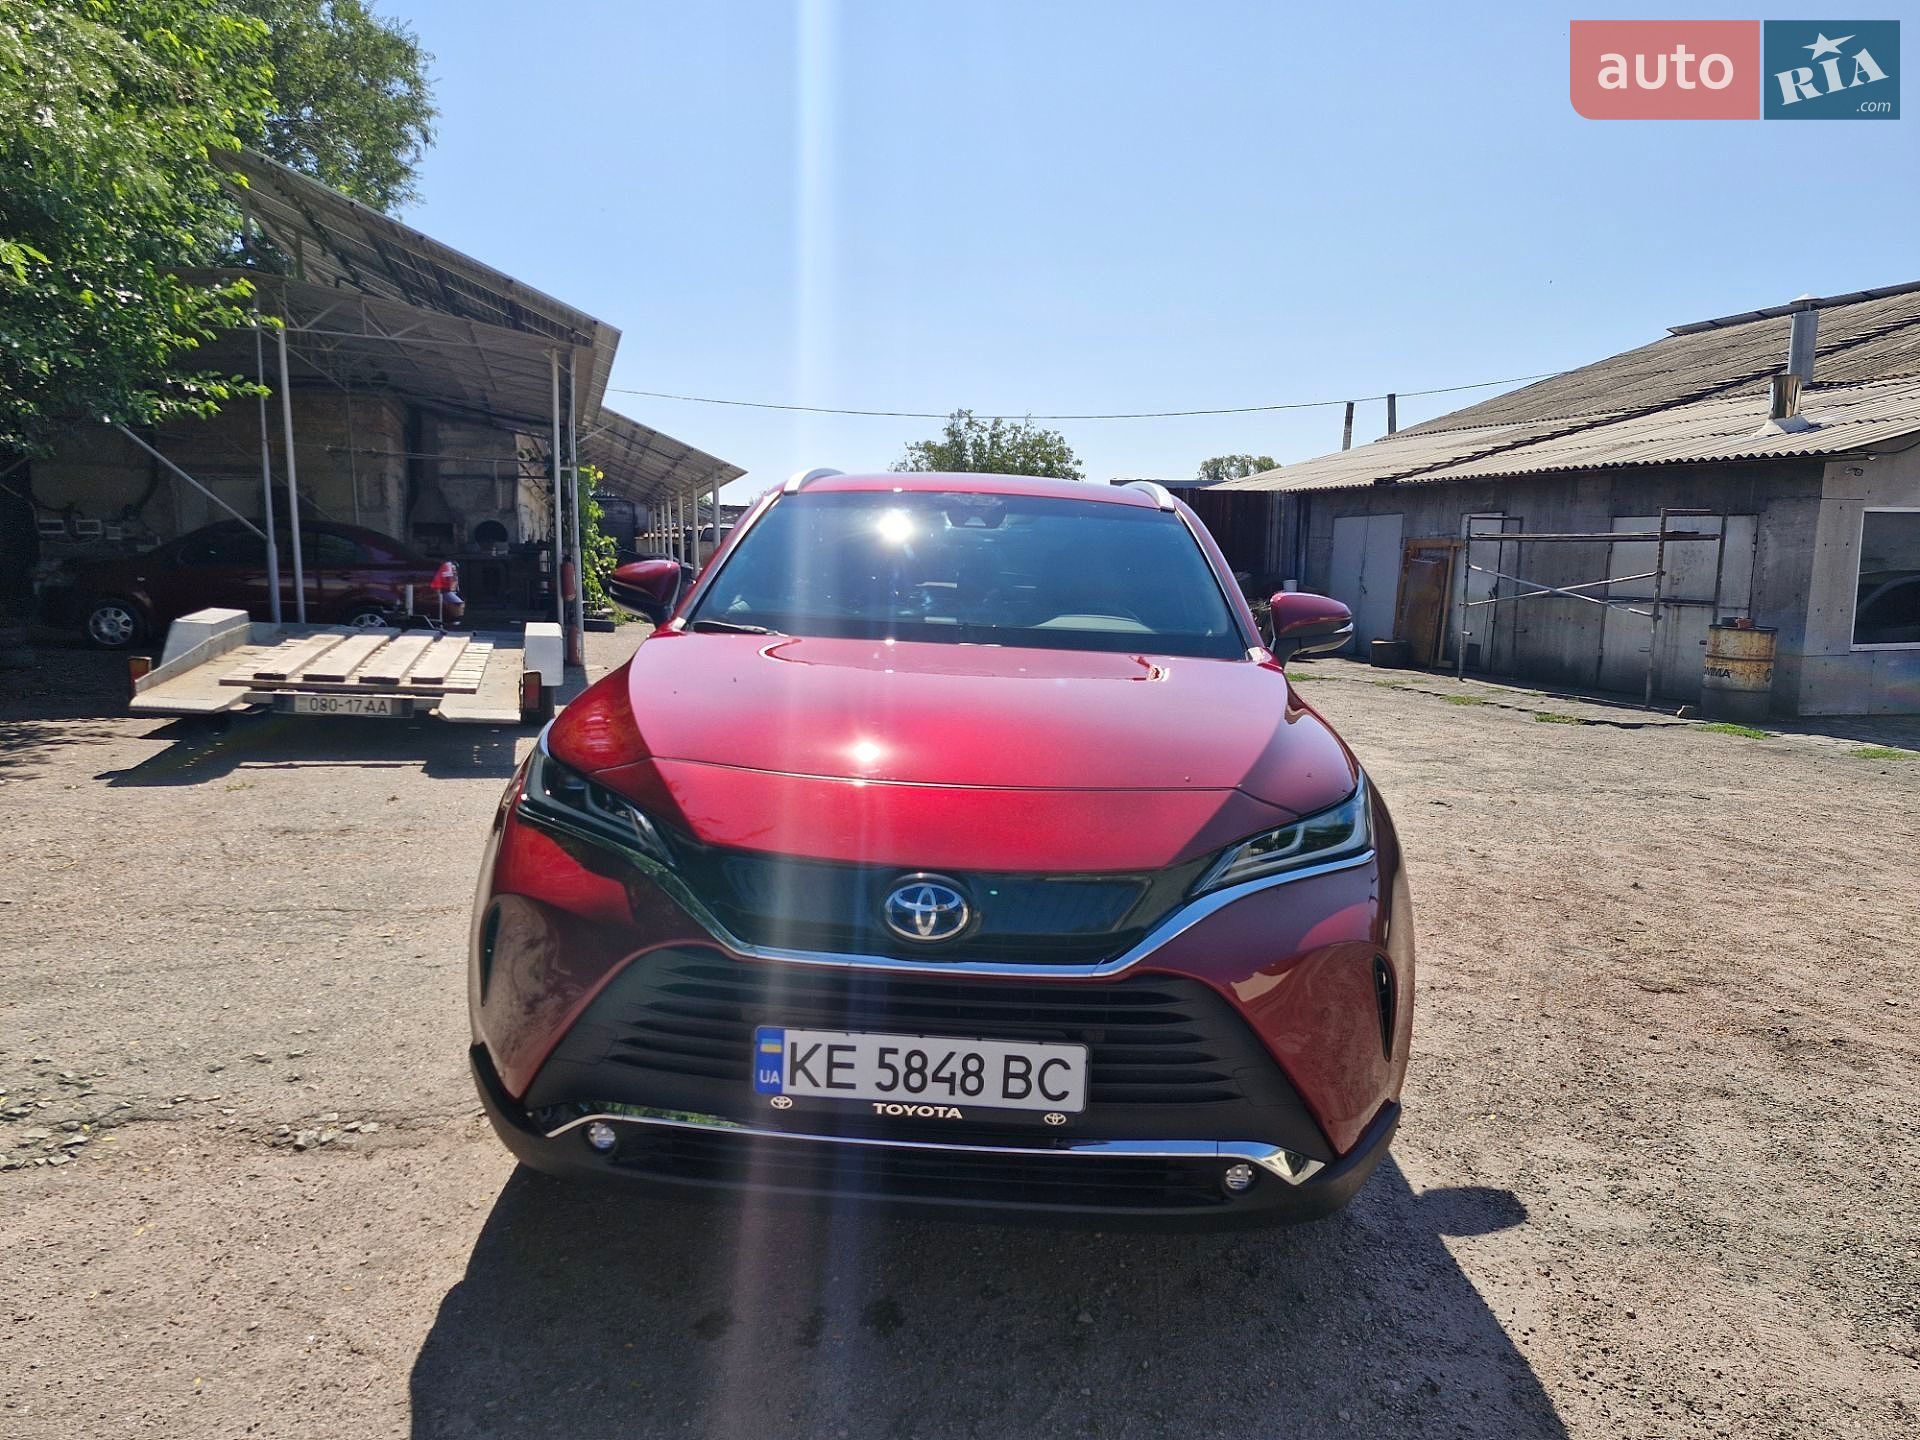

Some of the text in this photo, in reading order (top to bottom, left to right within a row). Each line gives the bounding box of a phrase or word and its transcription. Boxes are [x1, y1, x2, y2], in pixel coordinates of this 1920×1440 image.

[760, 1070, 780, 1085] UA
[789, 1042, 1072, 1102] KE 5848 BC
[873, 1102, 963, 1119] TOYOTA
